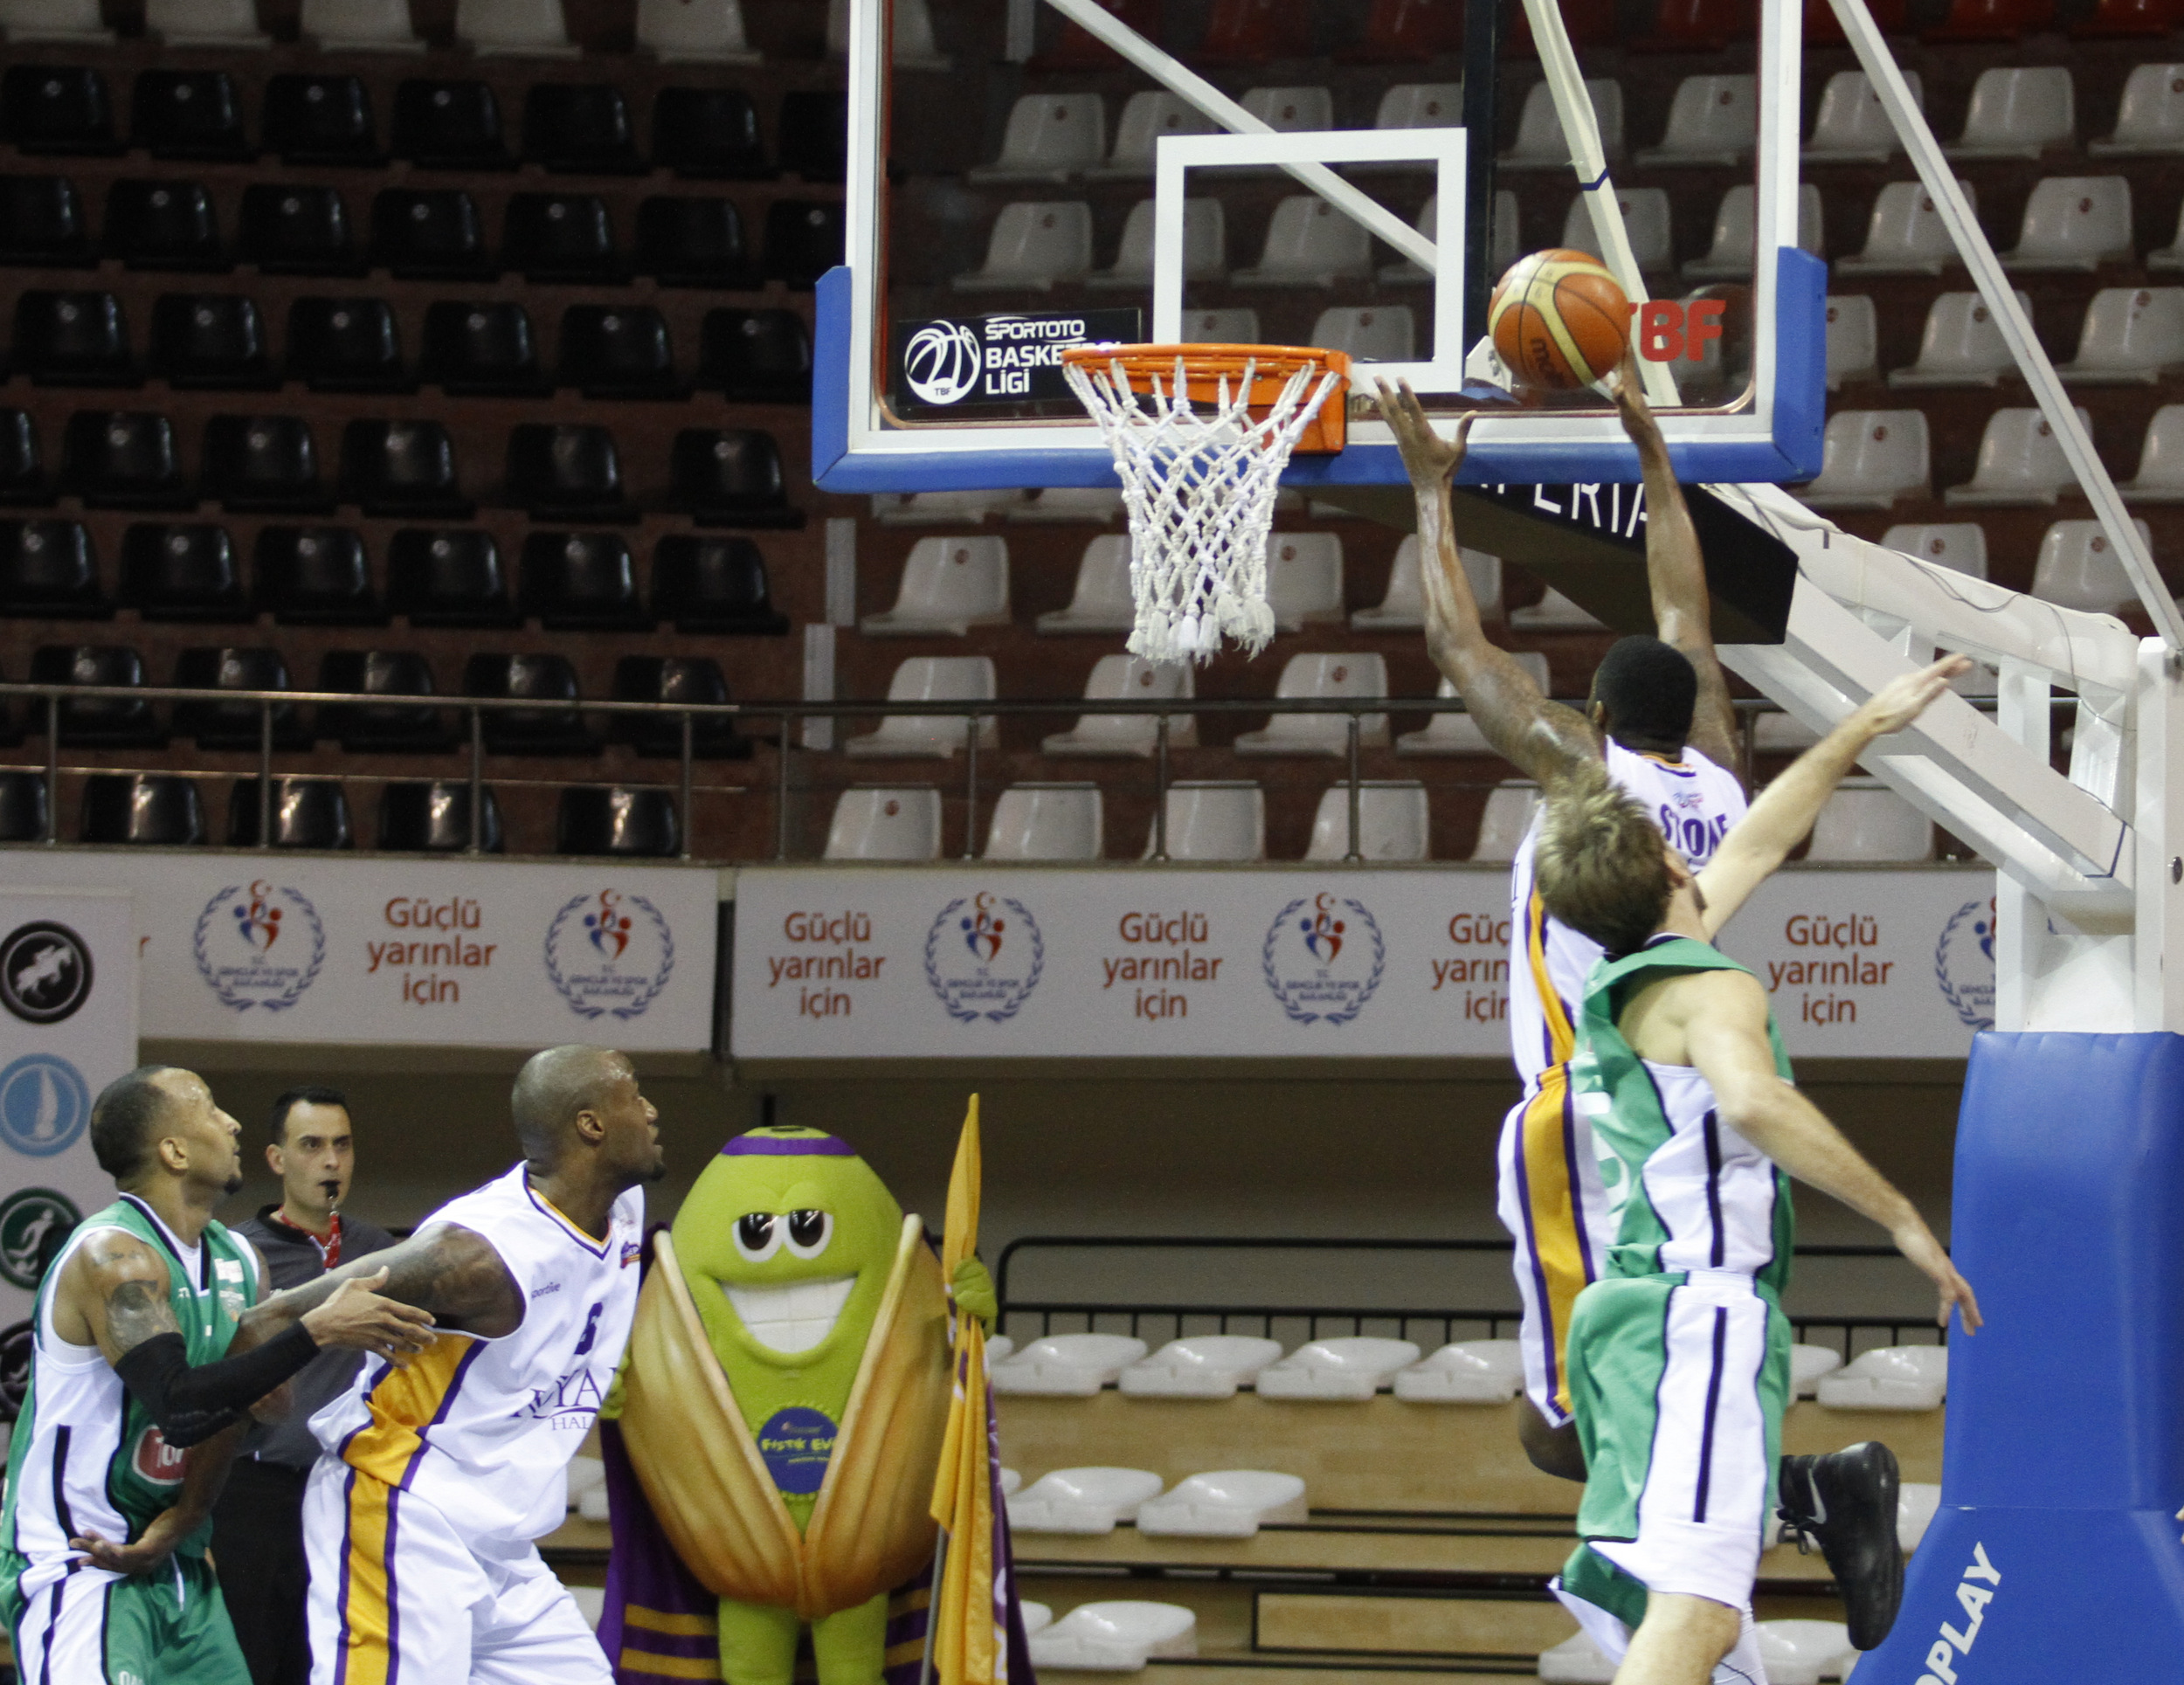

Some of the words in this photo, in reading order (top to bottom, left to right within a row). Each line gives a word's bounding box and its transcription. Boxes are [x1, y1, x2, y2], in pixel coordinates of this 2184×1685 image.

[1628, 300, 1726, 362] BF
[384, 896, 481, 932] Güçlü
[784, 910, 871, 945] Güçlü
[1120, 910, 1208, 946] Güçlü
[1449, 913, 1510, 947] Güç
[1785, 914, 1877, 950] Güçlü
[367, 934, 498, 974] yarınlar
[769, 948, 887, 988] yarınlar
[1102, 949, 1224, 989] yarınlar
[403, 972, 460, 1005] için
[1432, 958, 1510, 991] yarın
[1767, 953, 1894, 992] yarınlar
[800, 985, 852, 1019] için
[1136, 987, 1188, 1021] için
[1802, 993, 1856, 1026] için
